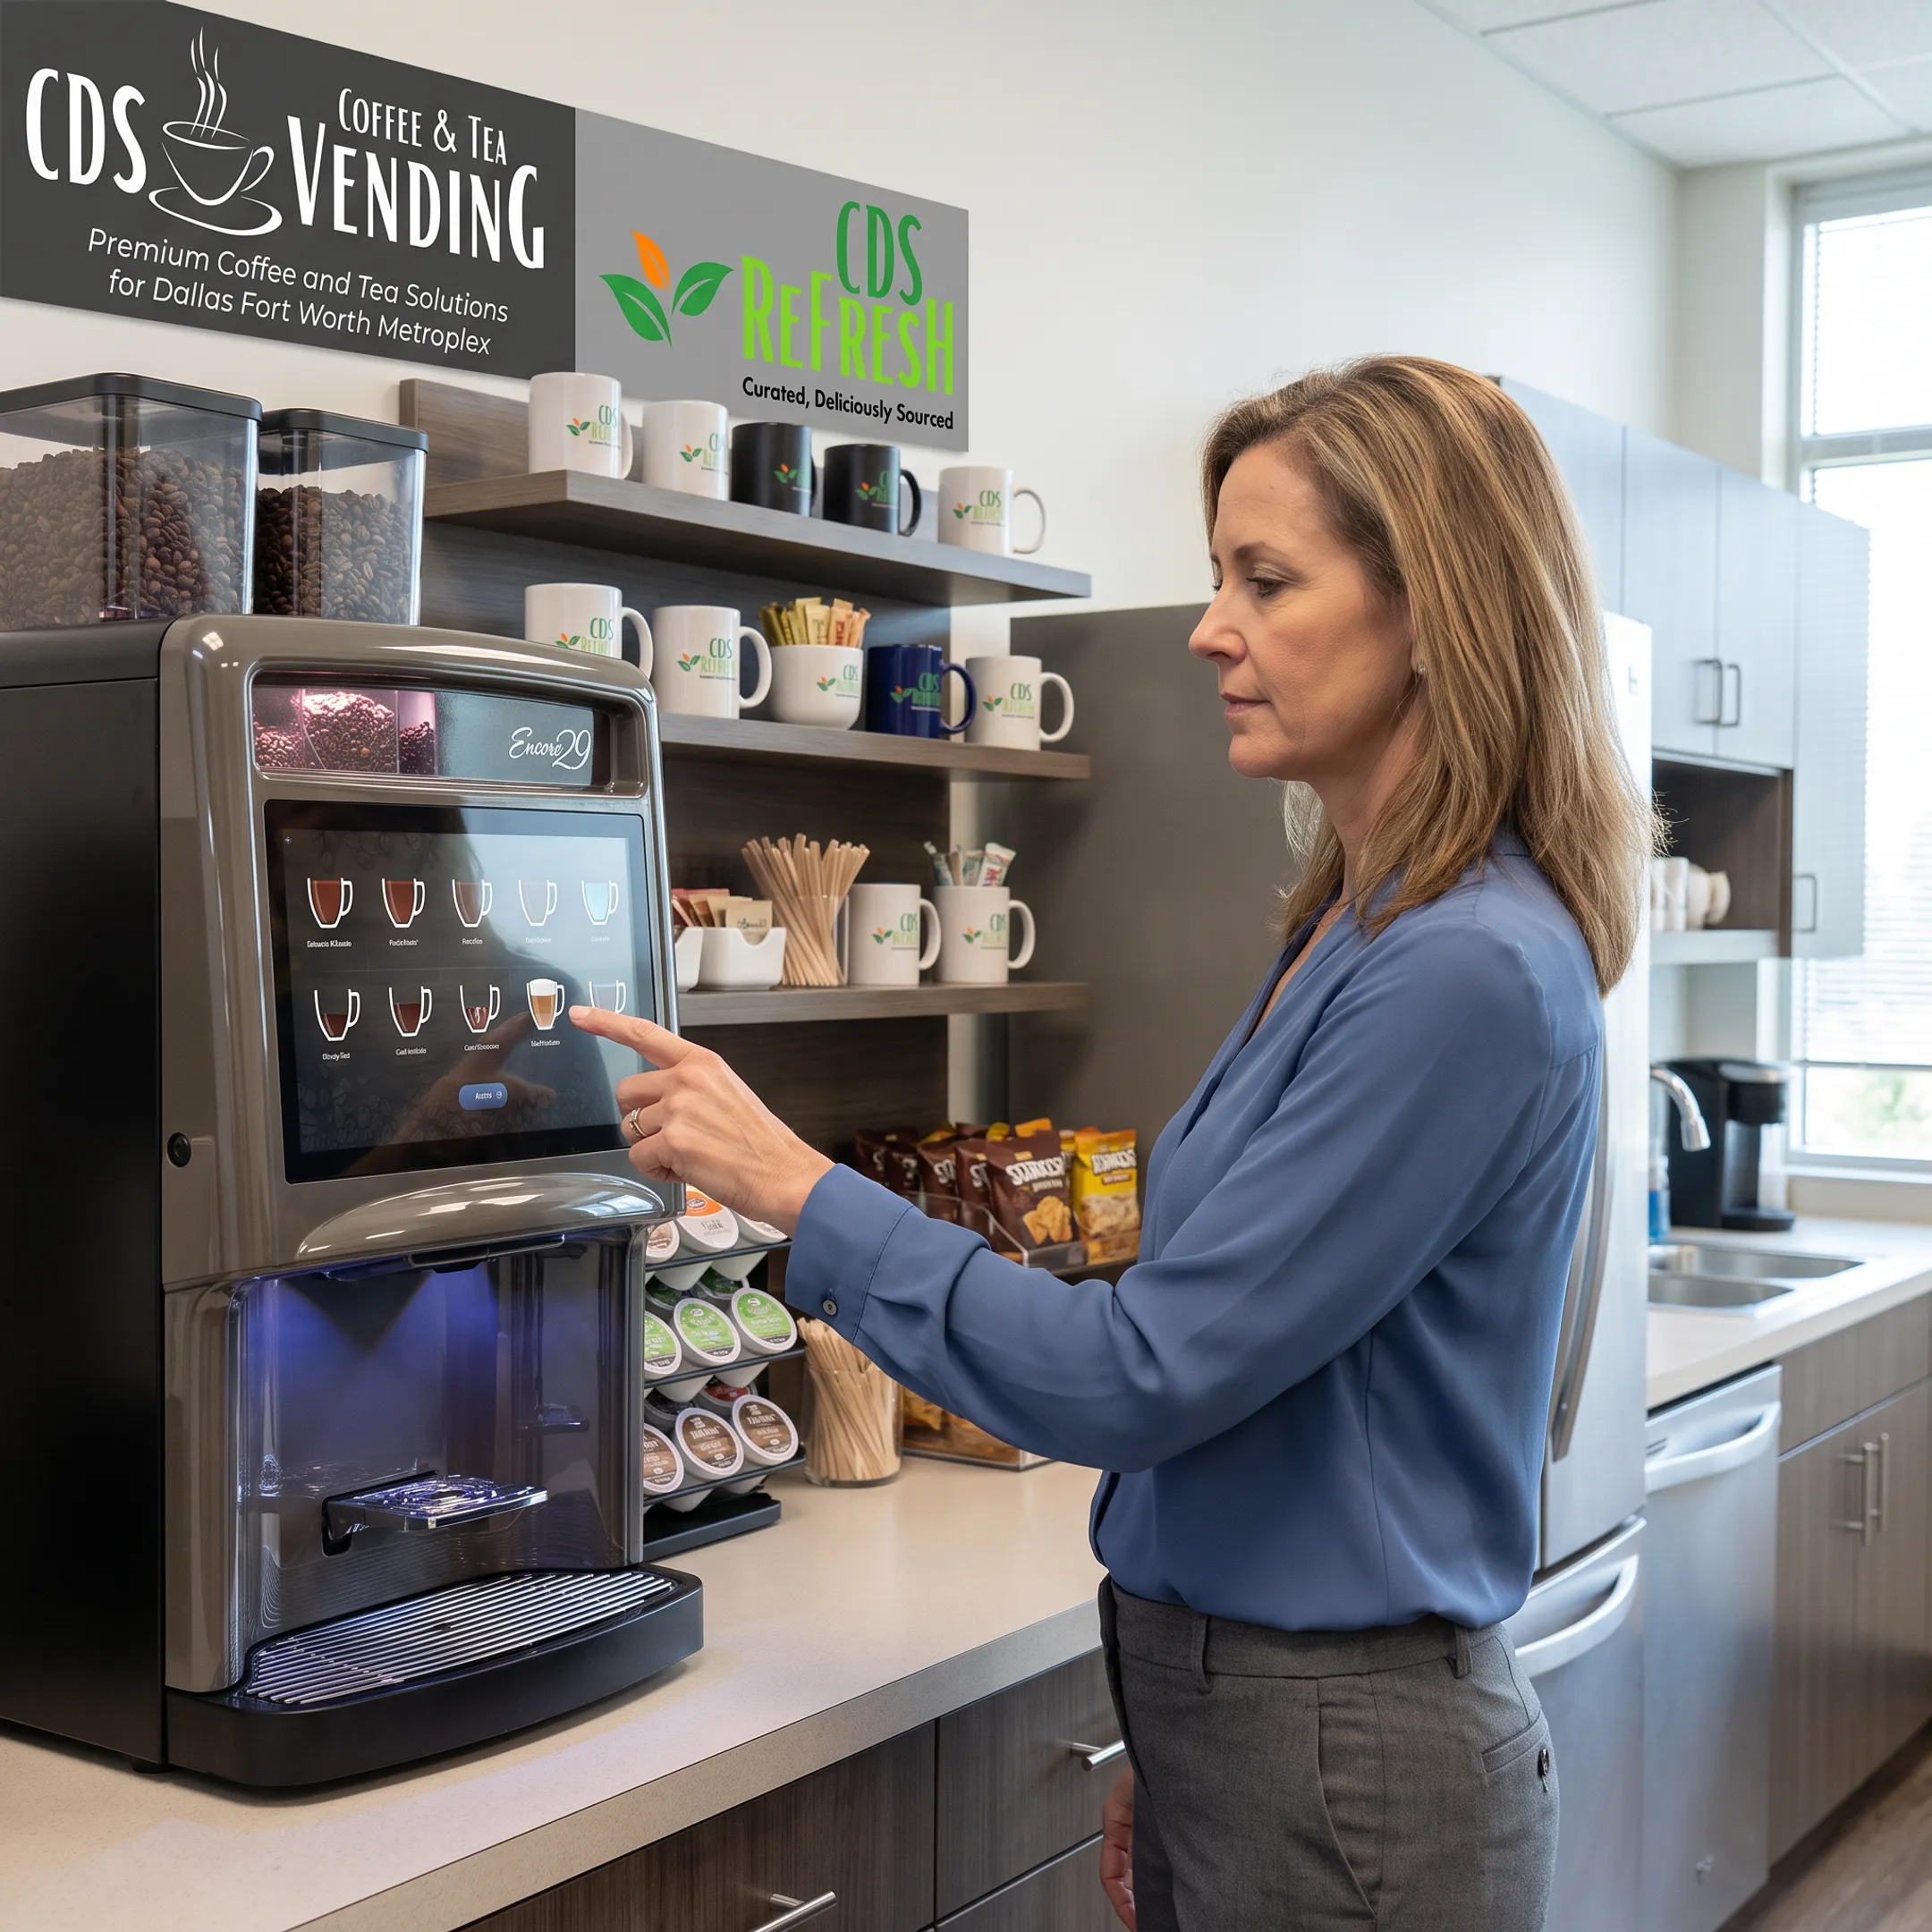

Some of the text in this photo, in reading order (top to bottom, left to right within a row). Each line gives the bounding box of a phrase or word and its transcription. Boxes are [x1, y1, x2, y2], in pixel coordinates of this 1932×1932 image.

[338, 89, 507, 166] COFFEE & TEA
[25, 68, 545, 269] CDS VENDING
[88, 227, 509, 323] Premium Coffee and Tea Solutions
[835, 201, 923, 306] CDS
[109, 268, 492, 355] for Dallas Fort Worth Metroplex
[741, 376, 954, 429] Curated, Deliciously Sourced
[979, 489, 1002, 508] CDS
[589, 617, 614, 640] CDS
[708, 638, 733, 659] CDS
[1010, 682, 1031, 701] CDS
